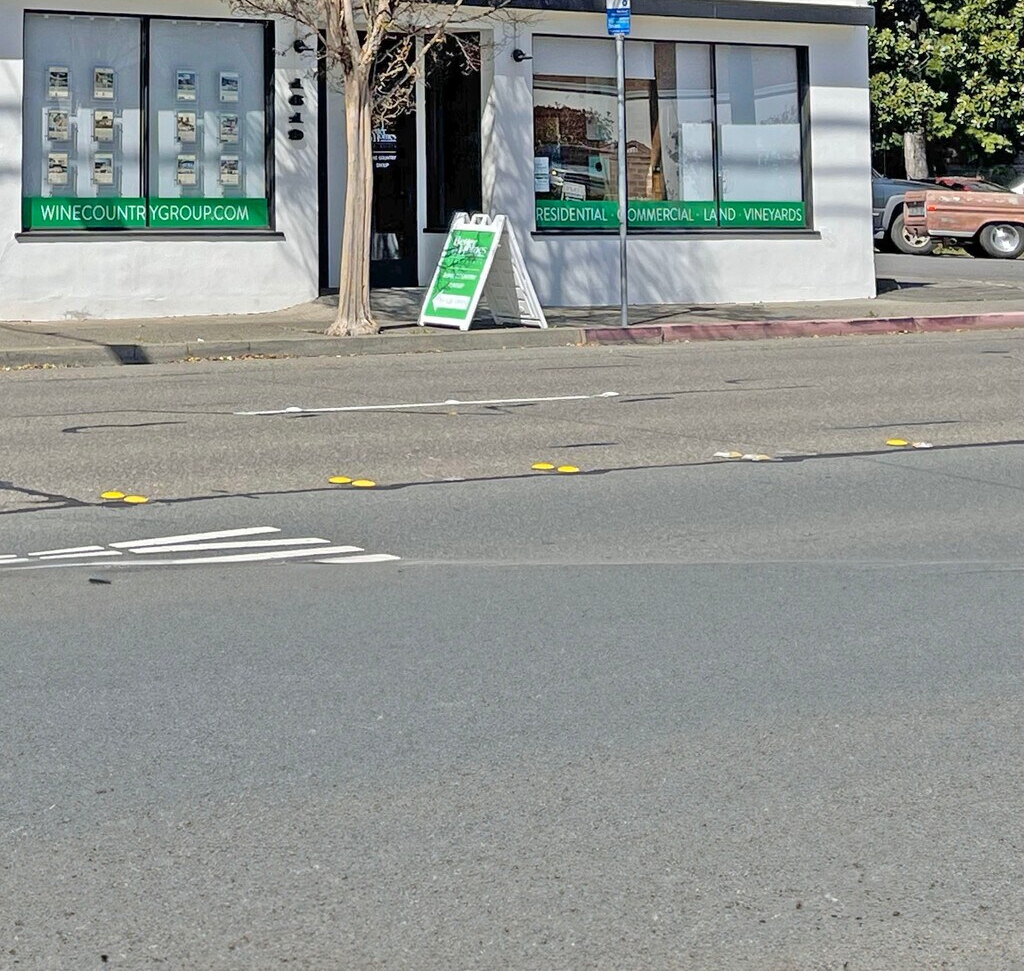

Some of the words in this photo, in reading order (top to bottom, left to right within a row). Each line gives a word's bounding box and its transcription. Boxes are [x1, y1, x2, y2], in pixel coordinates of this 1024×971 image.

[40, 204, 250, 222] WINECOUNTRYGROUP.COM
[536, 207, 608, 222] RESIDENTIAL
[703, 207, 736, 222] LAND
[743, 207, 802, 222] VINEYARDS
